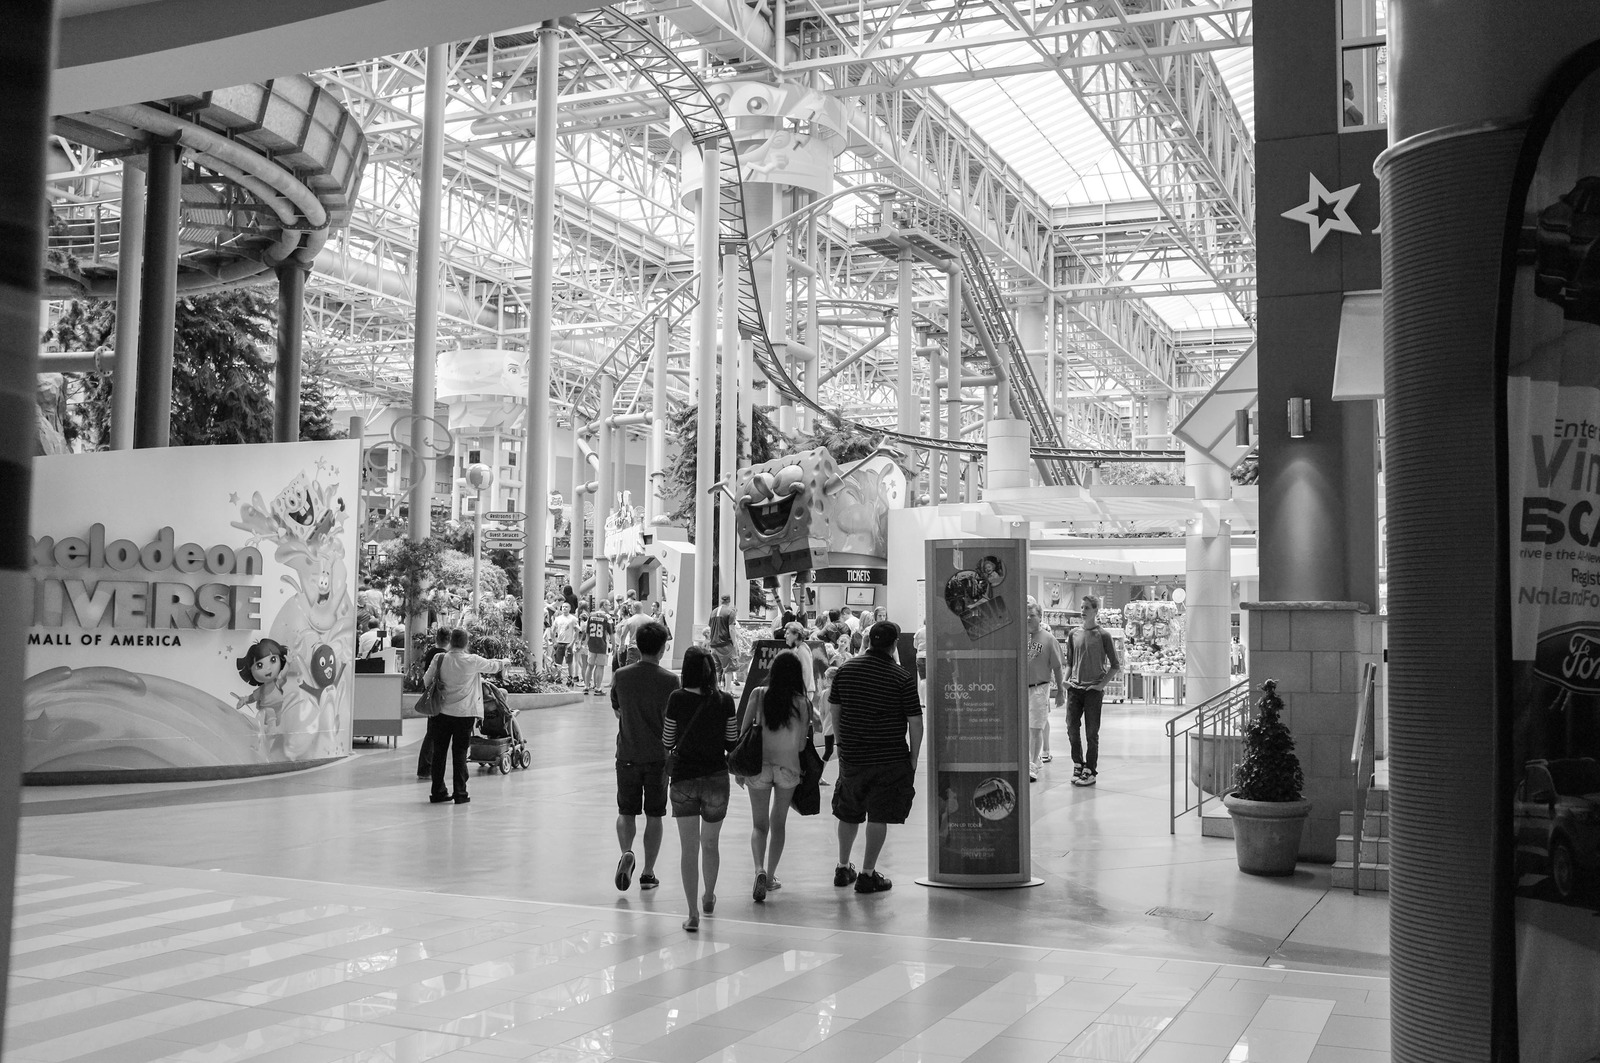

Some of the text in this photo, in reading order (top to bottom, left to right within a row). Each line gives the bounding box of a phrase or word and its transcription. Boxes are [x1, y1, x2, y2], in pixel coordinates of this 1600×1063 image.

[847, 569, 871, 582] TICKETS
[589, 623, 604, 638] 28
[28, 633, 183, 648] MALL OF AMERICA
[944, 682, 996, 693] ride. shop.
[944, 691, 971, 700] save.
